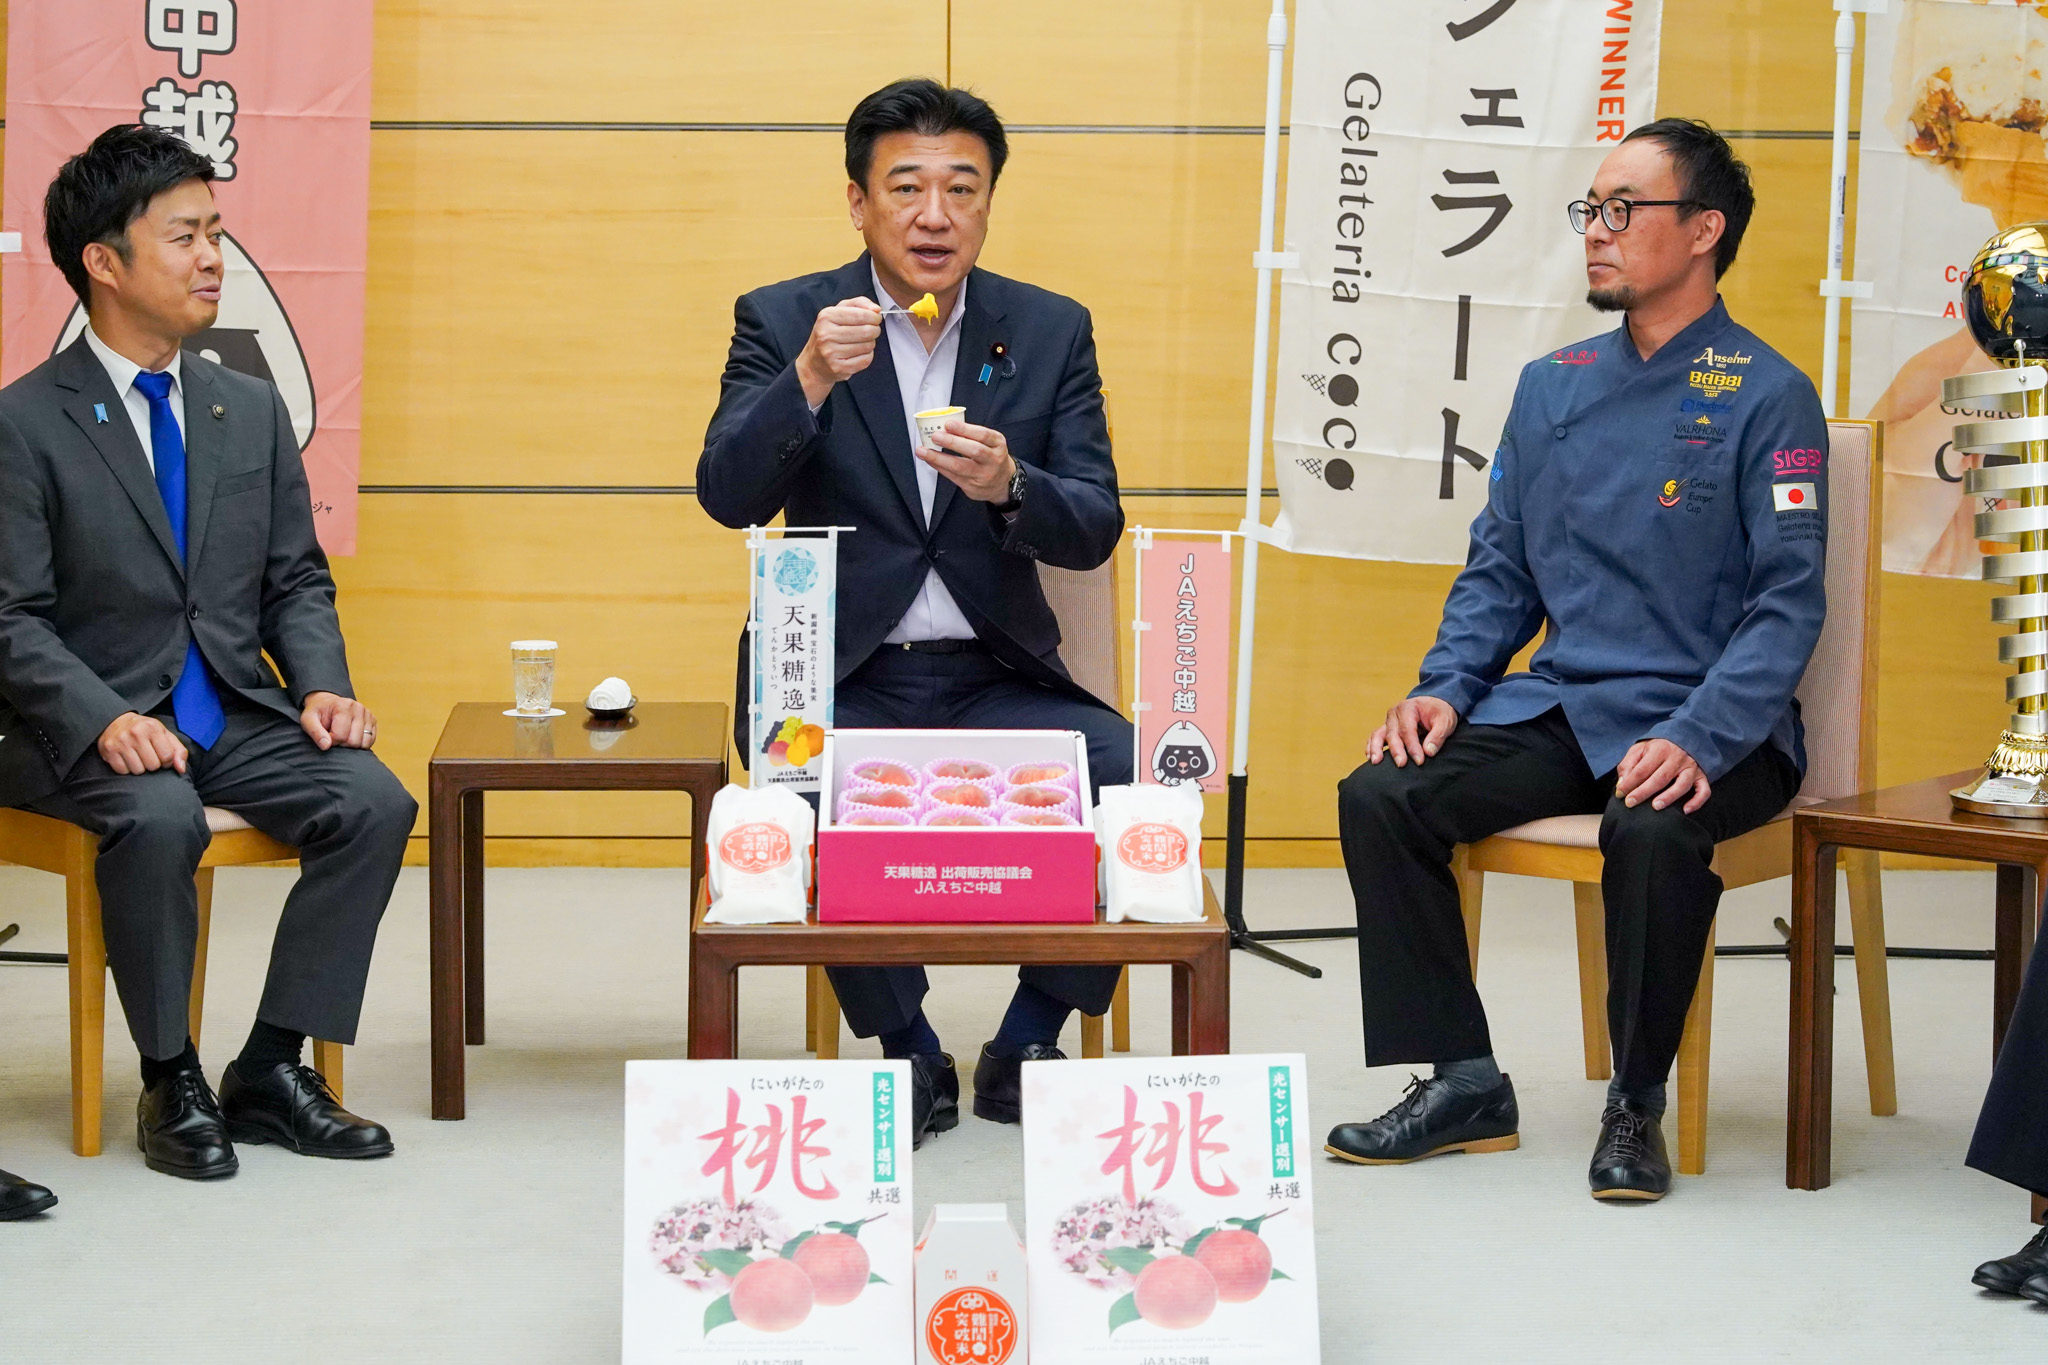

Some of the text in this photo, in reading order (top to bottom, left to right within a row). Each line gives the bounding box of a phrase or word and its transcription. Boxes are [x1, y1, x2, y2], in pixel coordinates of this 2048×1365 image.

[1597, 0, 1633, 142] WINNER
[1332, 73, 1381, 304] Gelateria
[1553, 350, 1598, 360] SARA
[1692, 347, 1752, 366] Anselmi
[1689, 371, 1742, 387] BABBI
[1675, 424, 1727, 438] VALRHONA
[1690, 479, 1718, 491] Gelato
[1687, 492, 1713, 504] Europe
[1685, 502, 1702, 516] Cup
[1776, 512, 1810, 522] MAESTRO
[1172, 553, 1198, 714] JAえちご中越
[781, 605, 806, 710] 天果糖逸
[884, 866, 1033, 879] 天果糖逸 出荷販売協議会
[914, 880, 1003, 894] JAえちご中越
[751, 1077, 825, 1091] にいがたの
[1147, 1072, 1221, 1088] にいがたの
[876, 1077, 893, 1177] 光センサー選別
[1271, 1071, 1291, 1172] 光センサー選別
[696, 1086, 841, 1211] 桃
[1095, 1084, 1241, 1211] 桃
[866, 1187, 901, 1204] 共選
[1266, 1182, 1301, 1200] 共選
